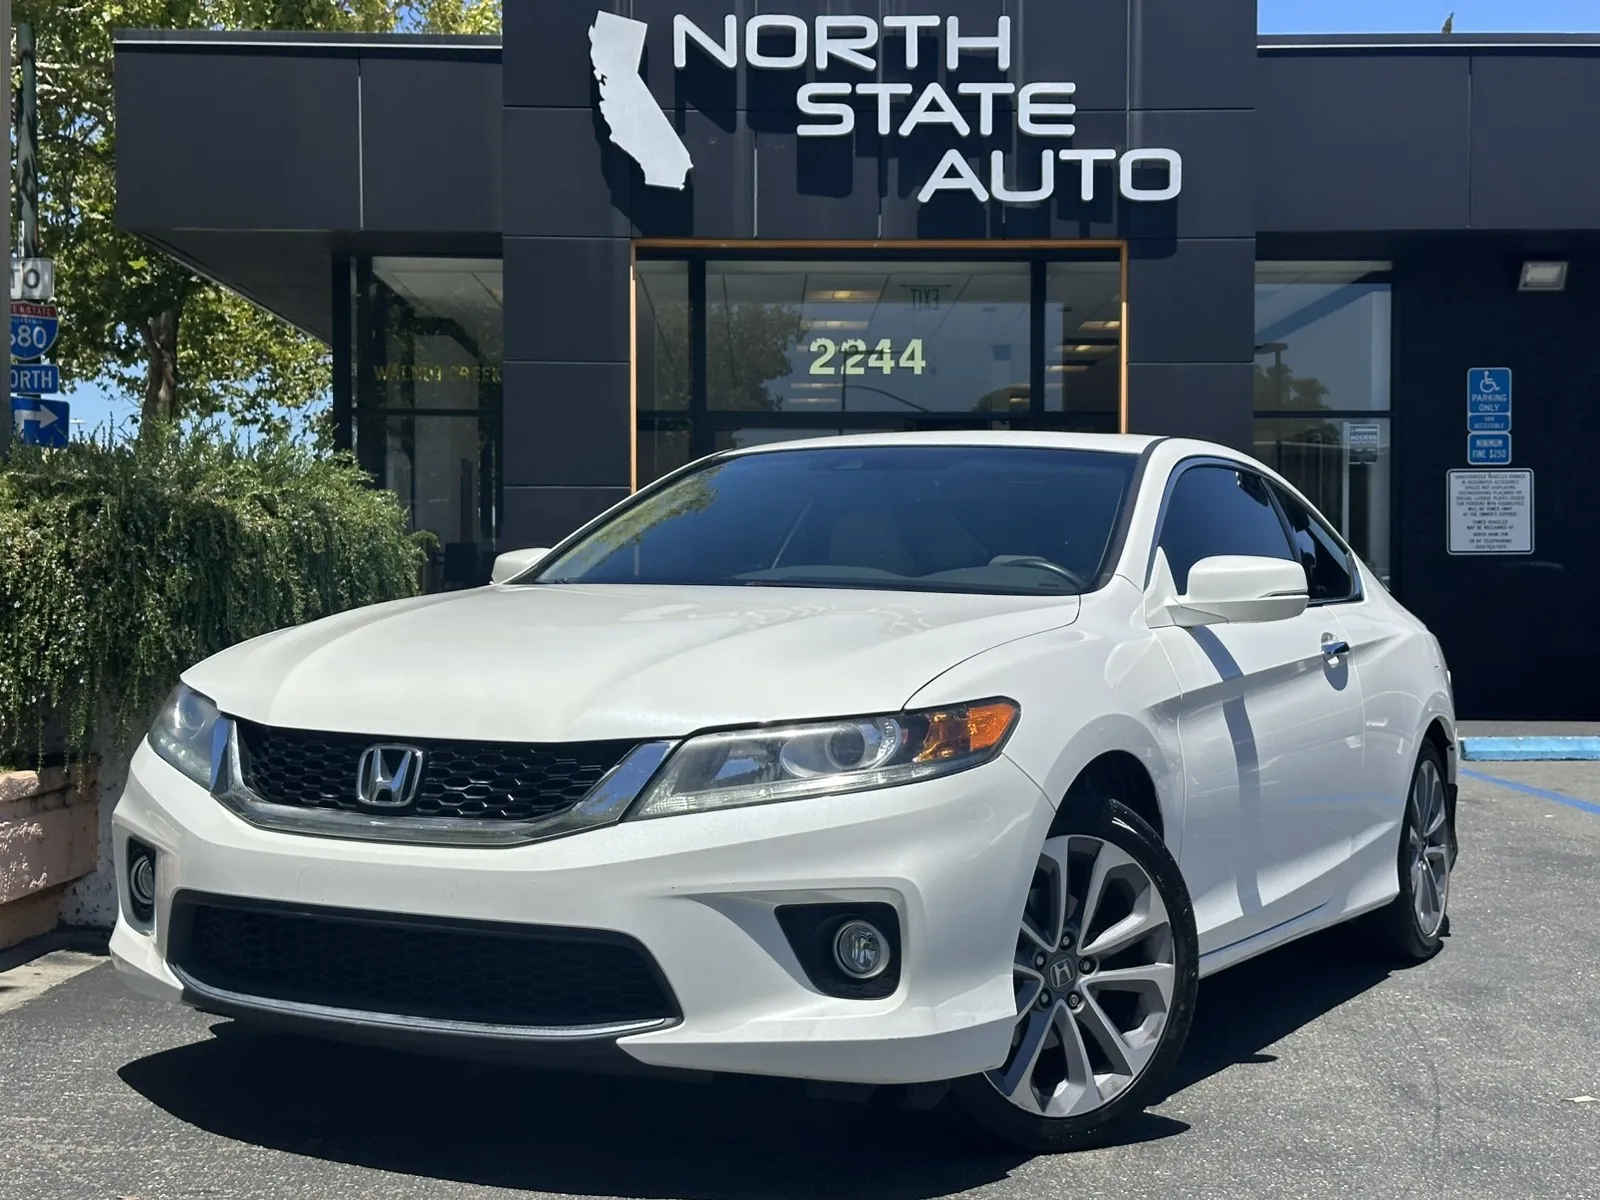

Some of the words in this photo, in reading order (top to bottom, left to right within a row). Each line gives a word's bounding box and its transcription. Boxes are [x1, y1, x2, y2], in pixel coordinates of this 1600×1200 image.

[672, 14, 1011, 72] NORTH
[795, 81, 1077, 137] STATE
[917, 147, 1183, 203] AUTO
[809, 337, 926, 375] 2244
[10, 369, 53, 389] ORTH
[1472, 394, 1507, 402] PARKING
[1478, 404, 1500, 412] ONLY
[1472, 449, 1487, 458] FINE
[1489, 449, 1507, 459] $250
